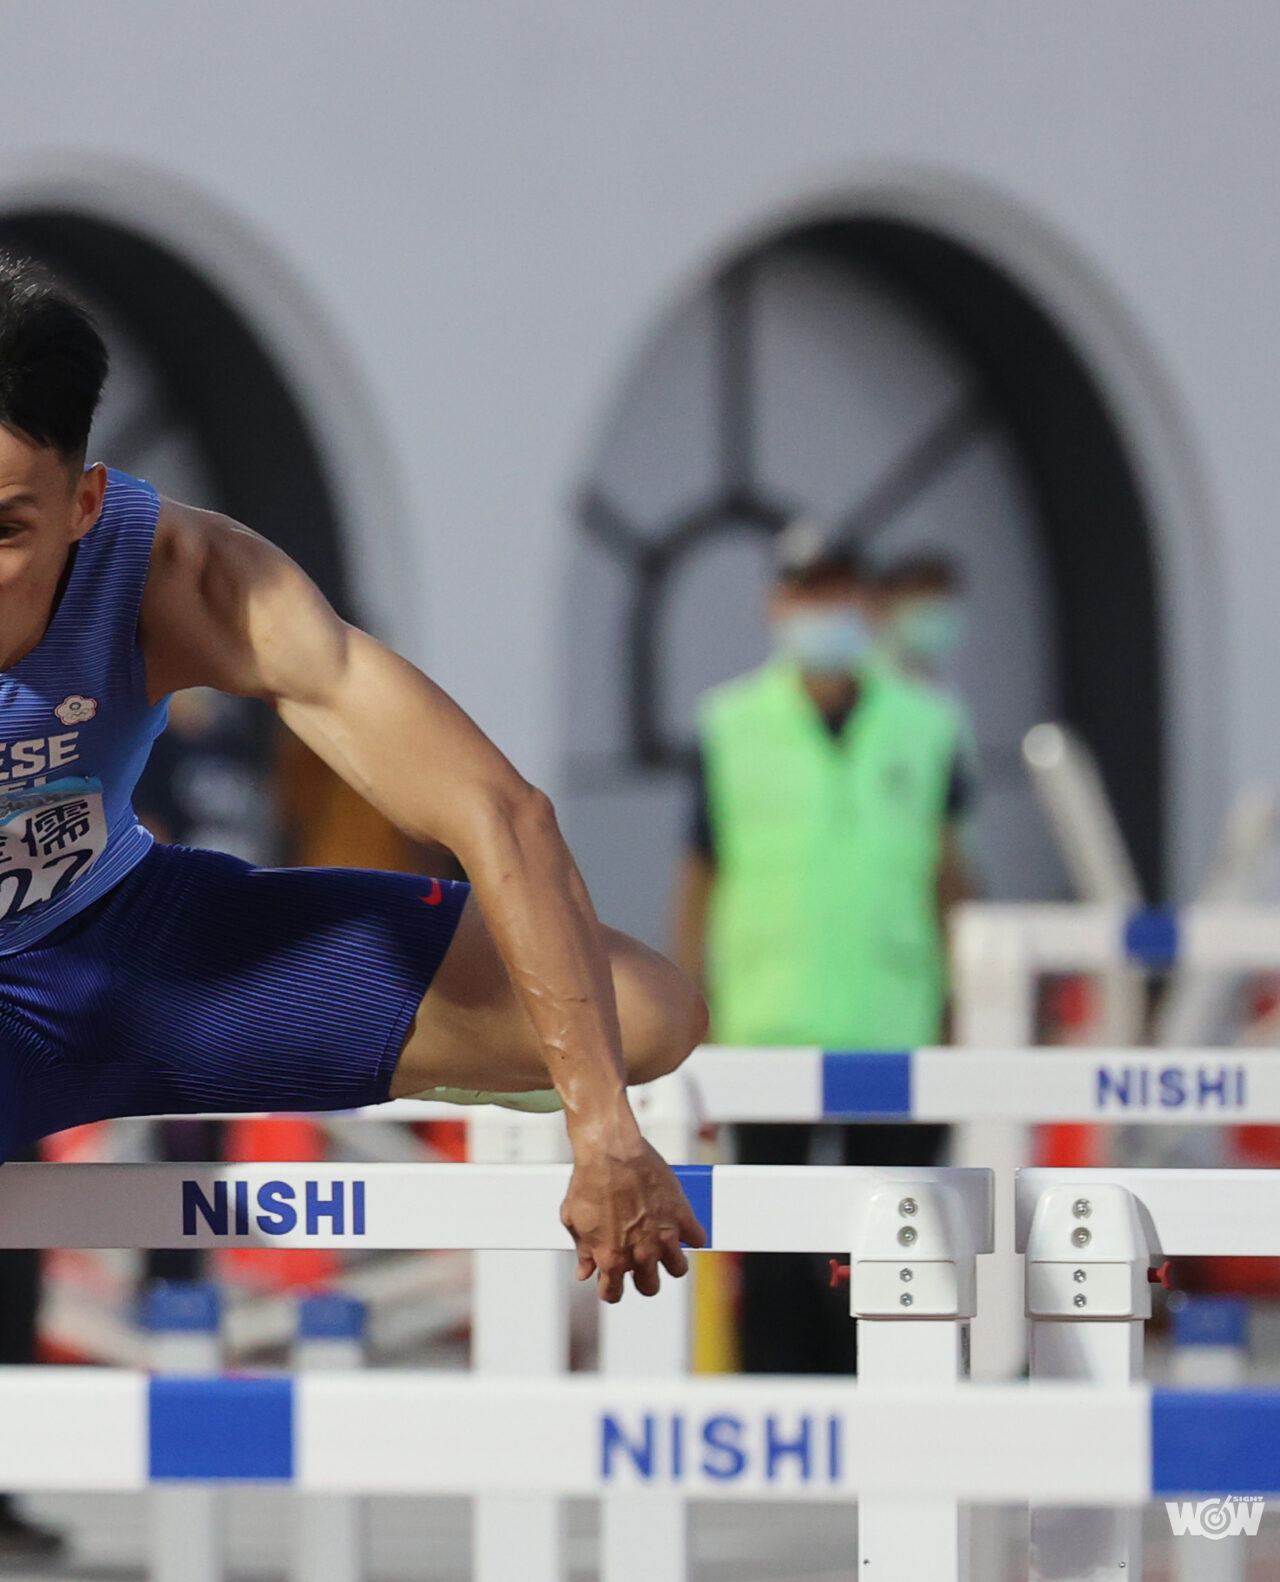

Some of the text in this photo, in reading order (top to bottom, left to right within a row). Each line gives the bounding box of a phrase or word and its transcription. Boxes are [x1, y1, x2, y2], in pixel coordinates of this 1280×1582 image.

[1094, 1065, 1248, 1109] NISHI
[182, 1180, 367, 1236] NISHI
[600, 1411, 843, 1482] NISHI
